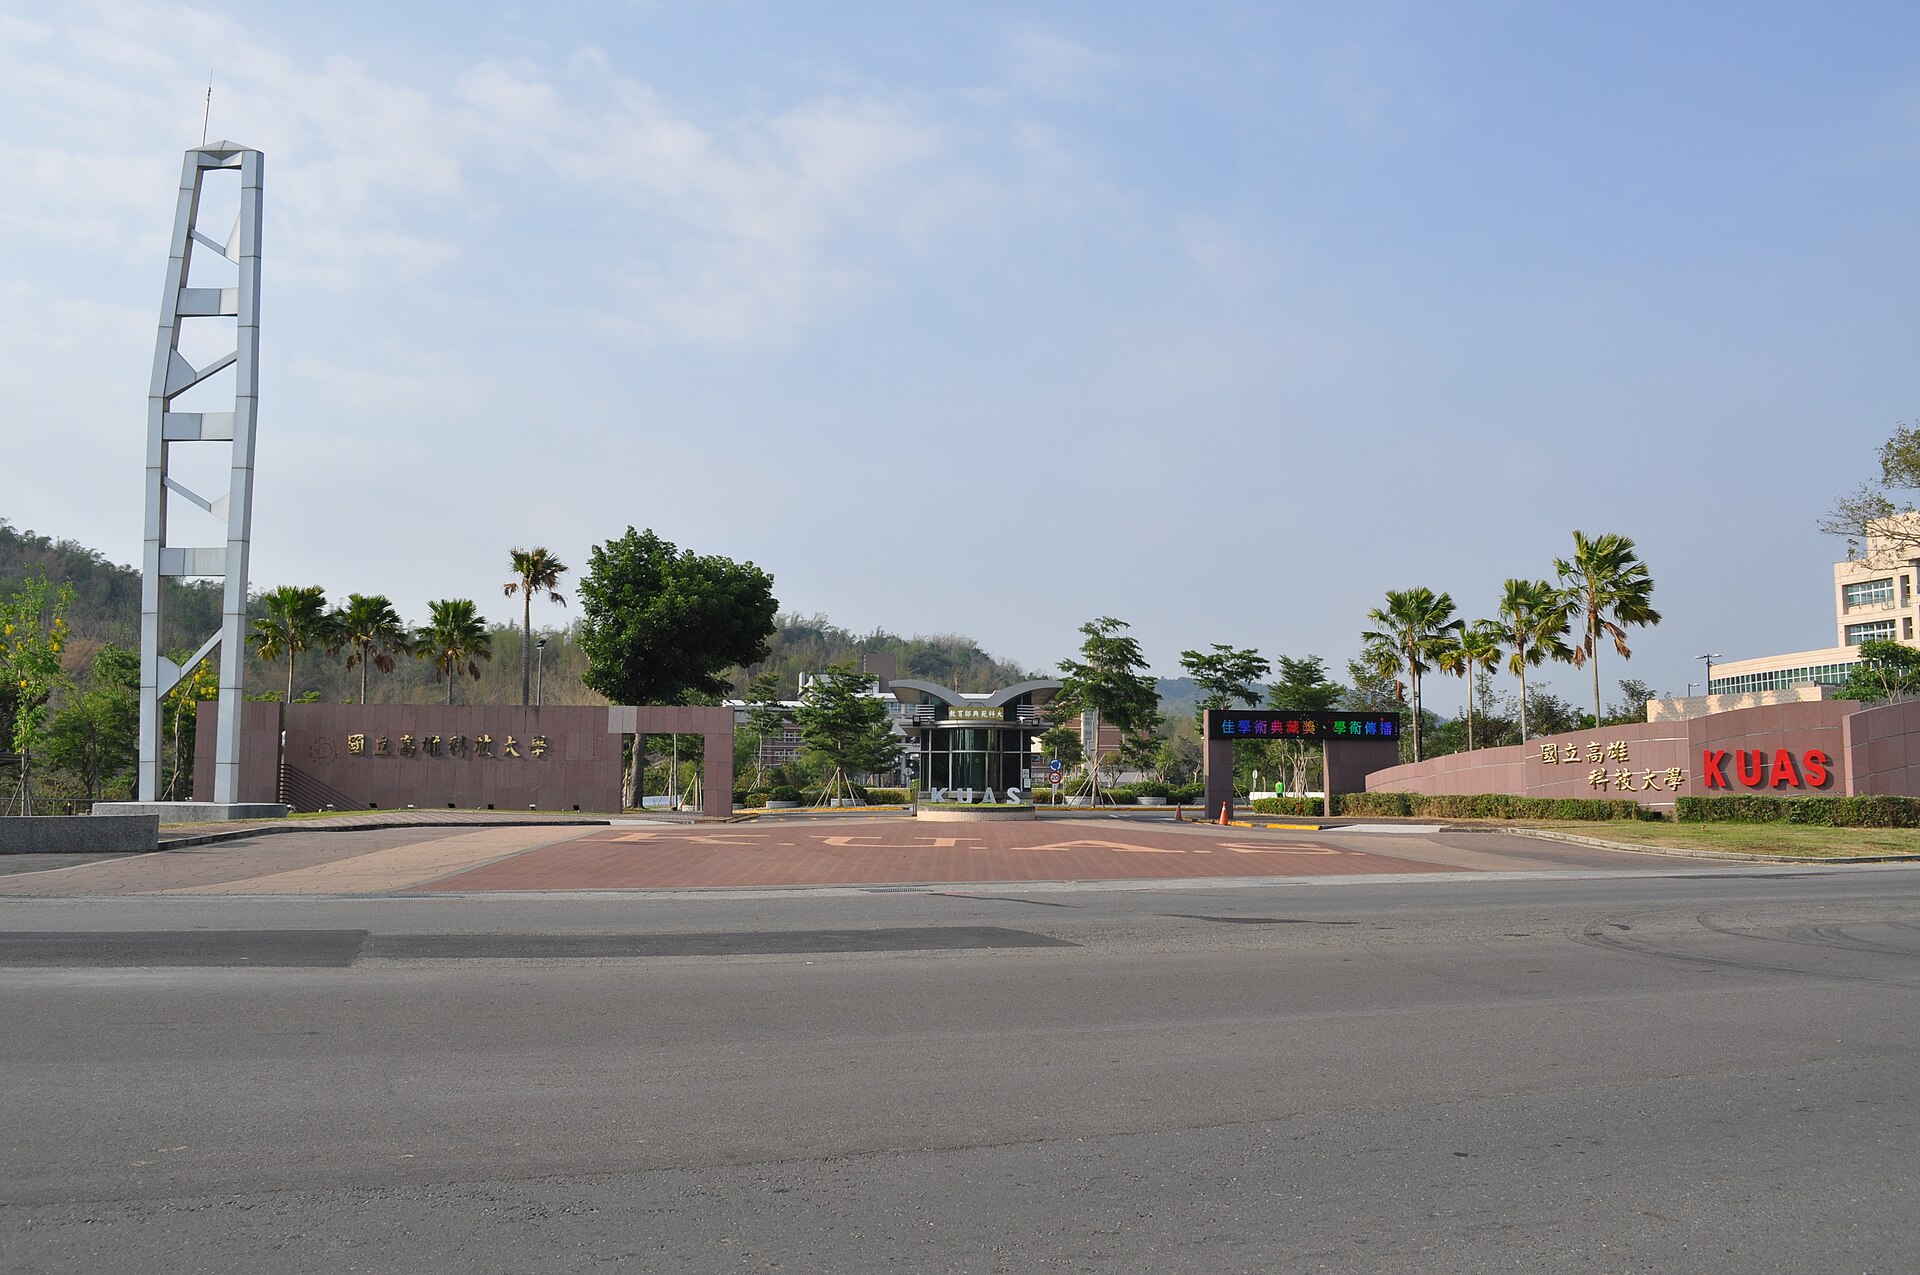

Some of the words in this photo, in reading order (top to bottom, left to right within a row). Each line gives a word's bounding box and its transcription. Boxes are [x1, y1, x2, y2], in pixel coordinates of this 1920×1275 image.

[347, 733, 548, 759] 國立高雄科技大學
[1539, 740, 1630, 765] 國立高雄
[1588, 766, 1686, 792] 科技大學
[1703, 749, 1827, 787] KUAS
[931, 787, 1021, 804] KUAS
